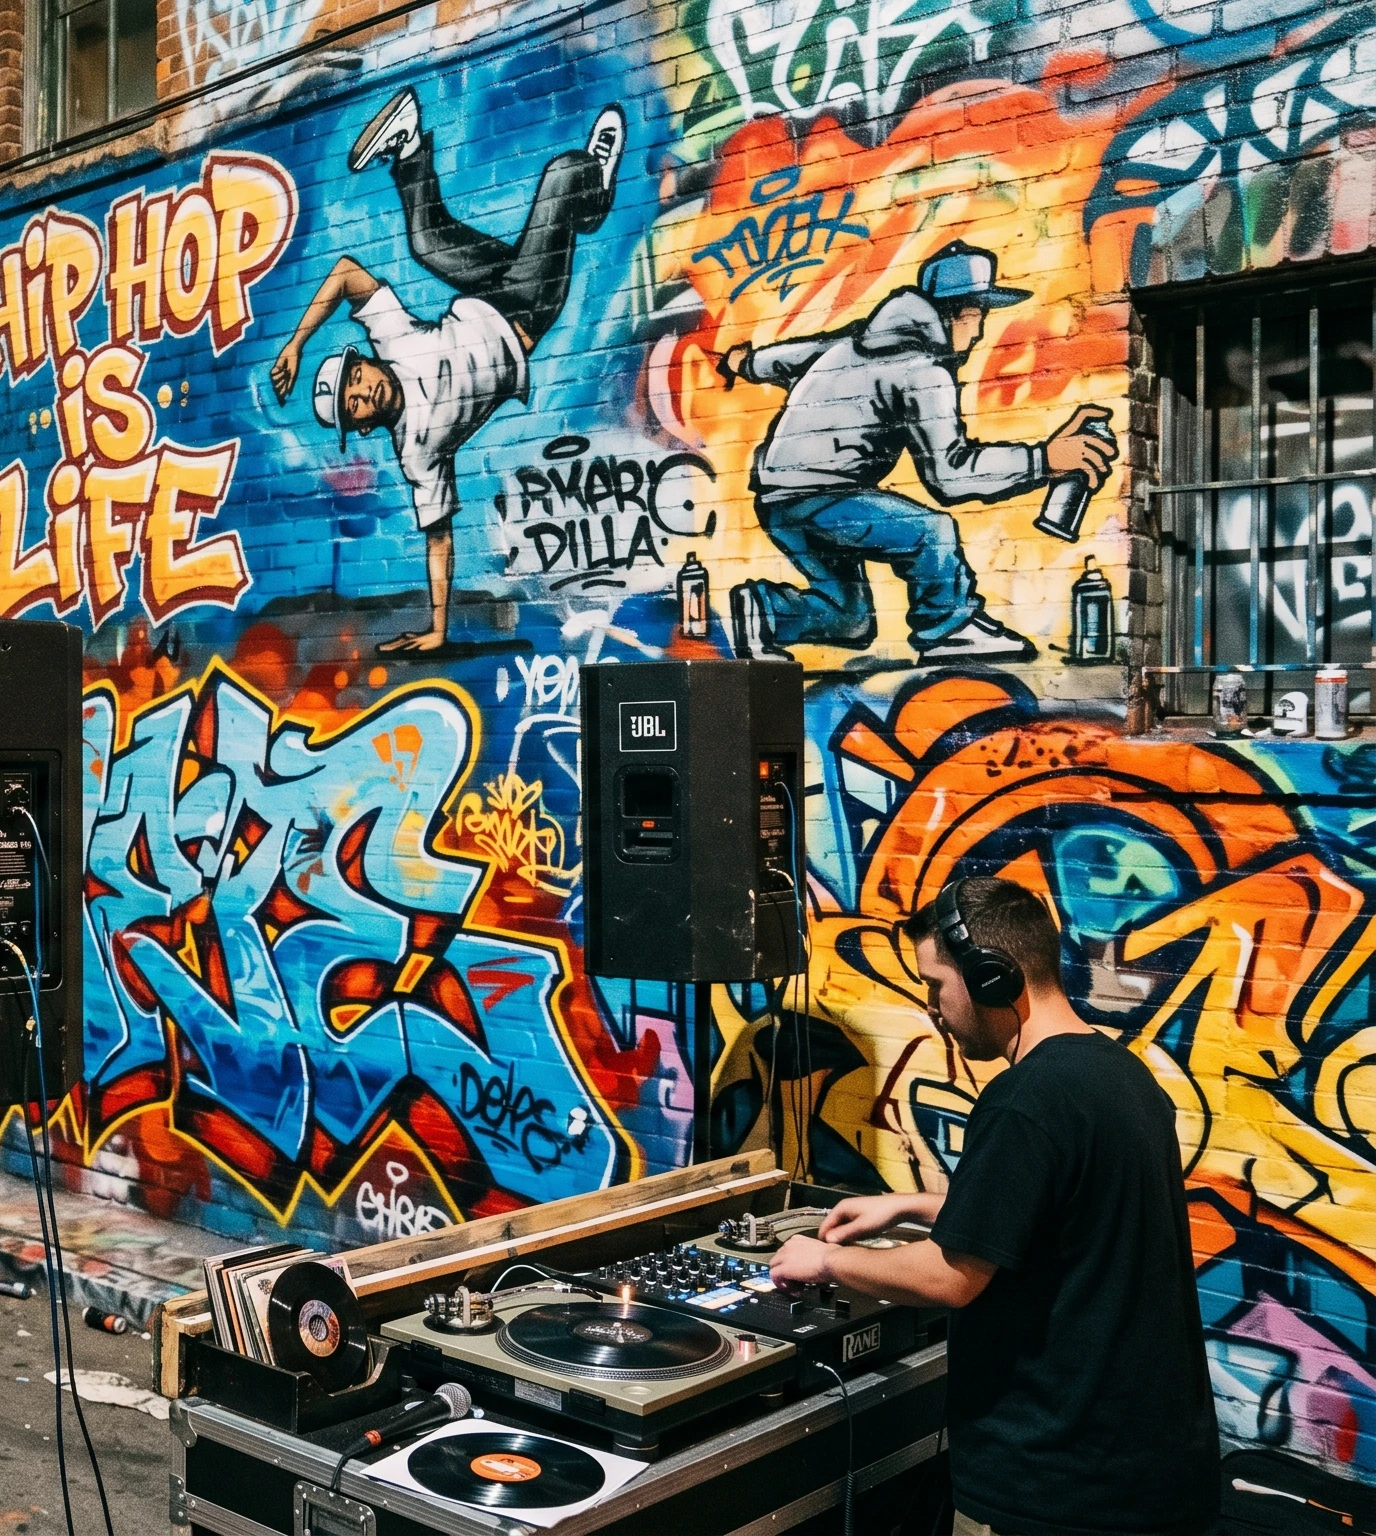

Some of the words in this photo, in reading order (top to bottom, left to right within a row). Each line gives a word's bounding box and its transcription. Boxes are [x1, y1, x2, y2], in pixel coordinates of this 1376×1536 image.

[105, 150, 299, 358] HOP
[524, 515, 665, 572] DILLA
[630, 715, 666, 737] JBL
[842, 1322, 881, 1363] RANE
